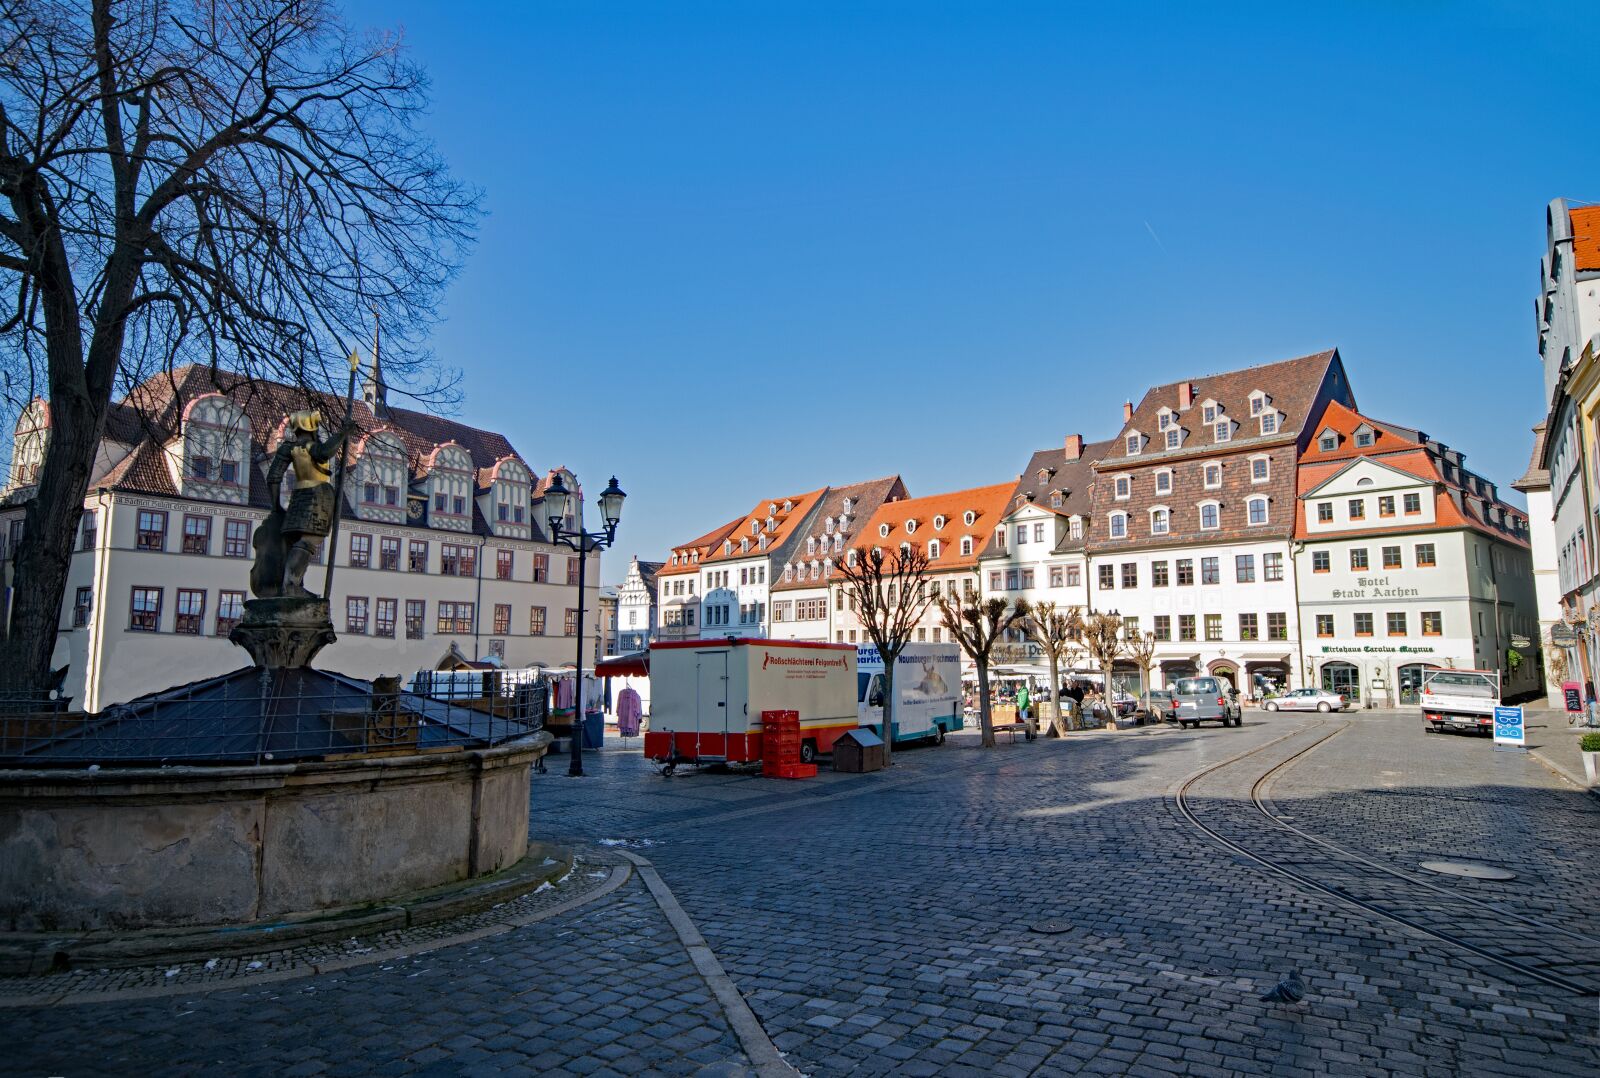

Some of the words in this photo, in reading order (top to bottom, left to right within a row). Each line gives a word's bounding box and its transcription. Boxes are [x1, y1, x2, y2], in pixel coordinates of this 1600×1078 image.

[1357, 576, 1389, 586] Hotel
[1332, 589, 1365, 598] Stadt
[1372, 587, 1419, 597] Aachen
[1322, 645, 1362, 653] Wirtshaus
[1363, 645, 1396, 653] Carolus
[1399, 645, 1434, 654] Magnus
